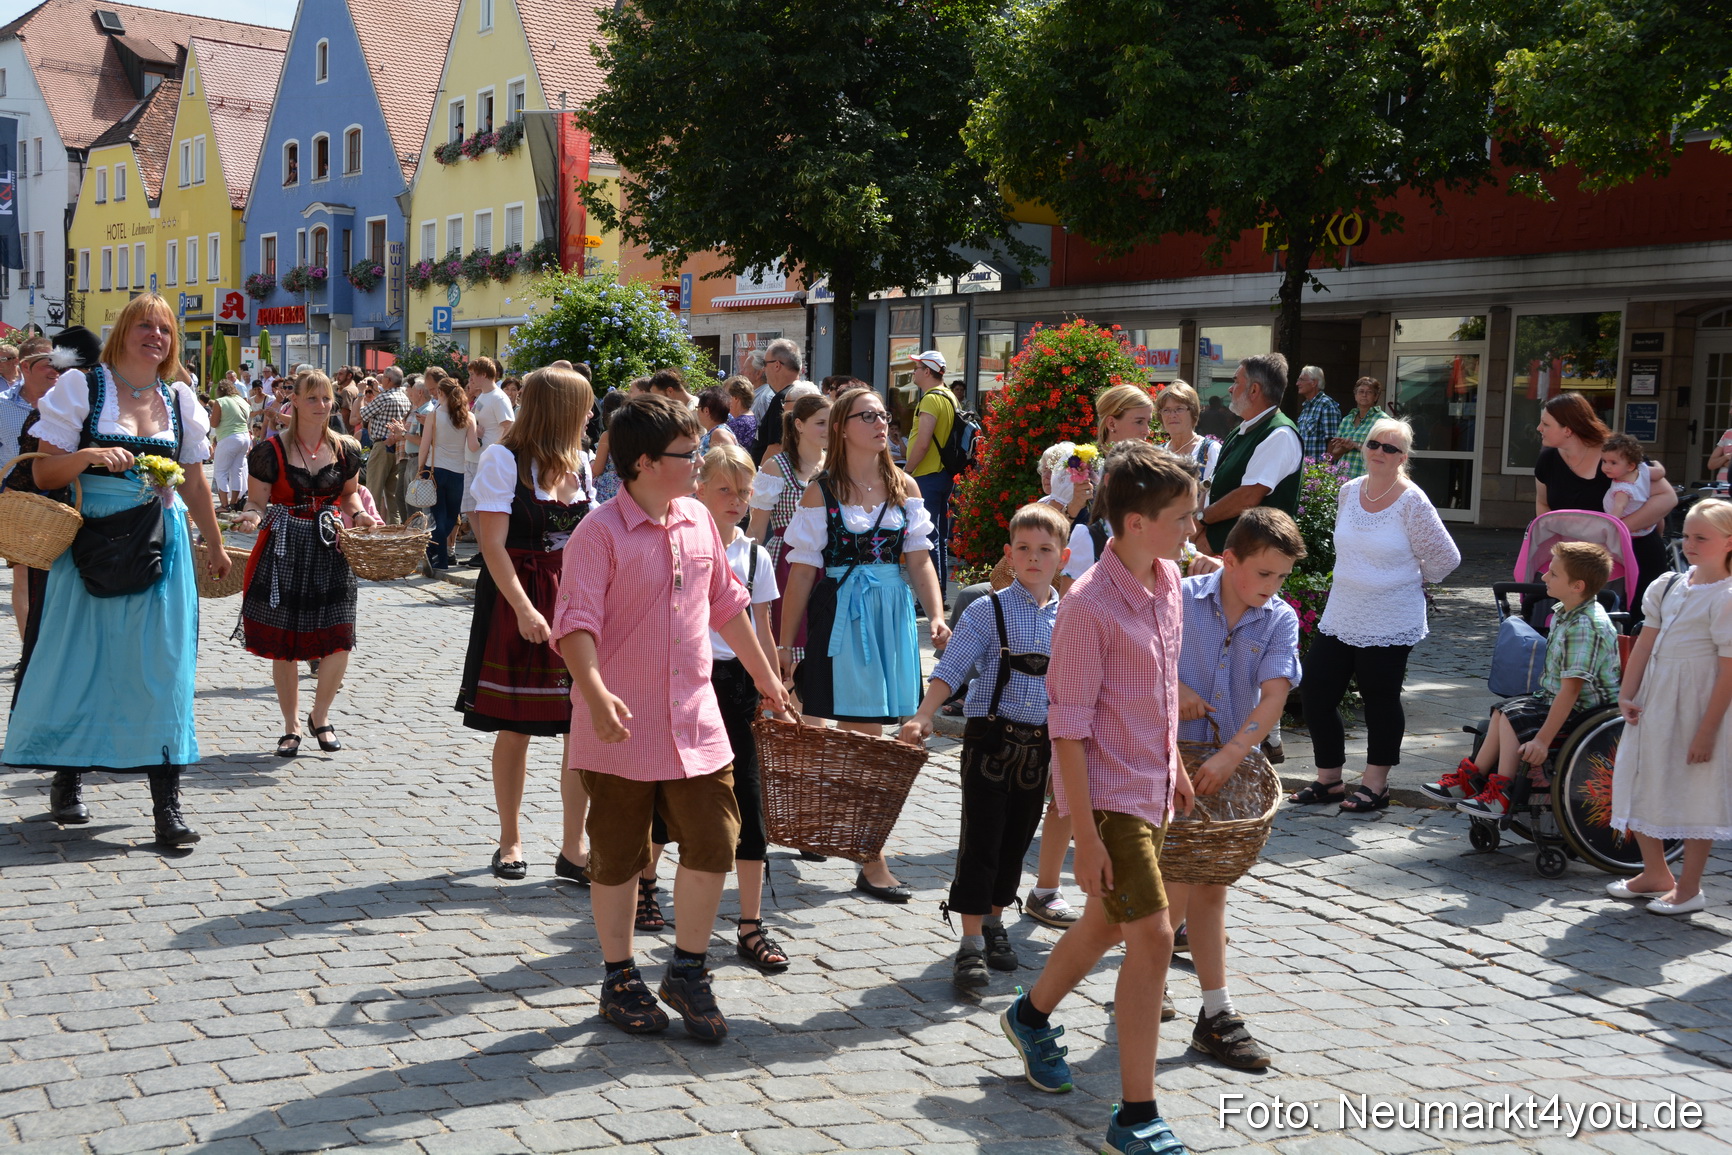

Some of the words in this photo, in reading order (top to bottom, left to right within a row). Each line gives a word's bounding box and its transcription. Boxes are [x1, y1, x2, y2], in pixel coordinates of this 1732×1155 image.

[106, 223, 127, 240] HOTEL
[131, 222, 155, 236] Lehmeier
[683, 278, 690, 304] P
[186, 297, 198, 308] FUN
[104, 308, 116, 322] Rest
[255, 306, 306, 326] APOTHEKE
[436, 309, 448, 331] P
